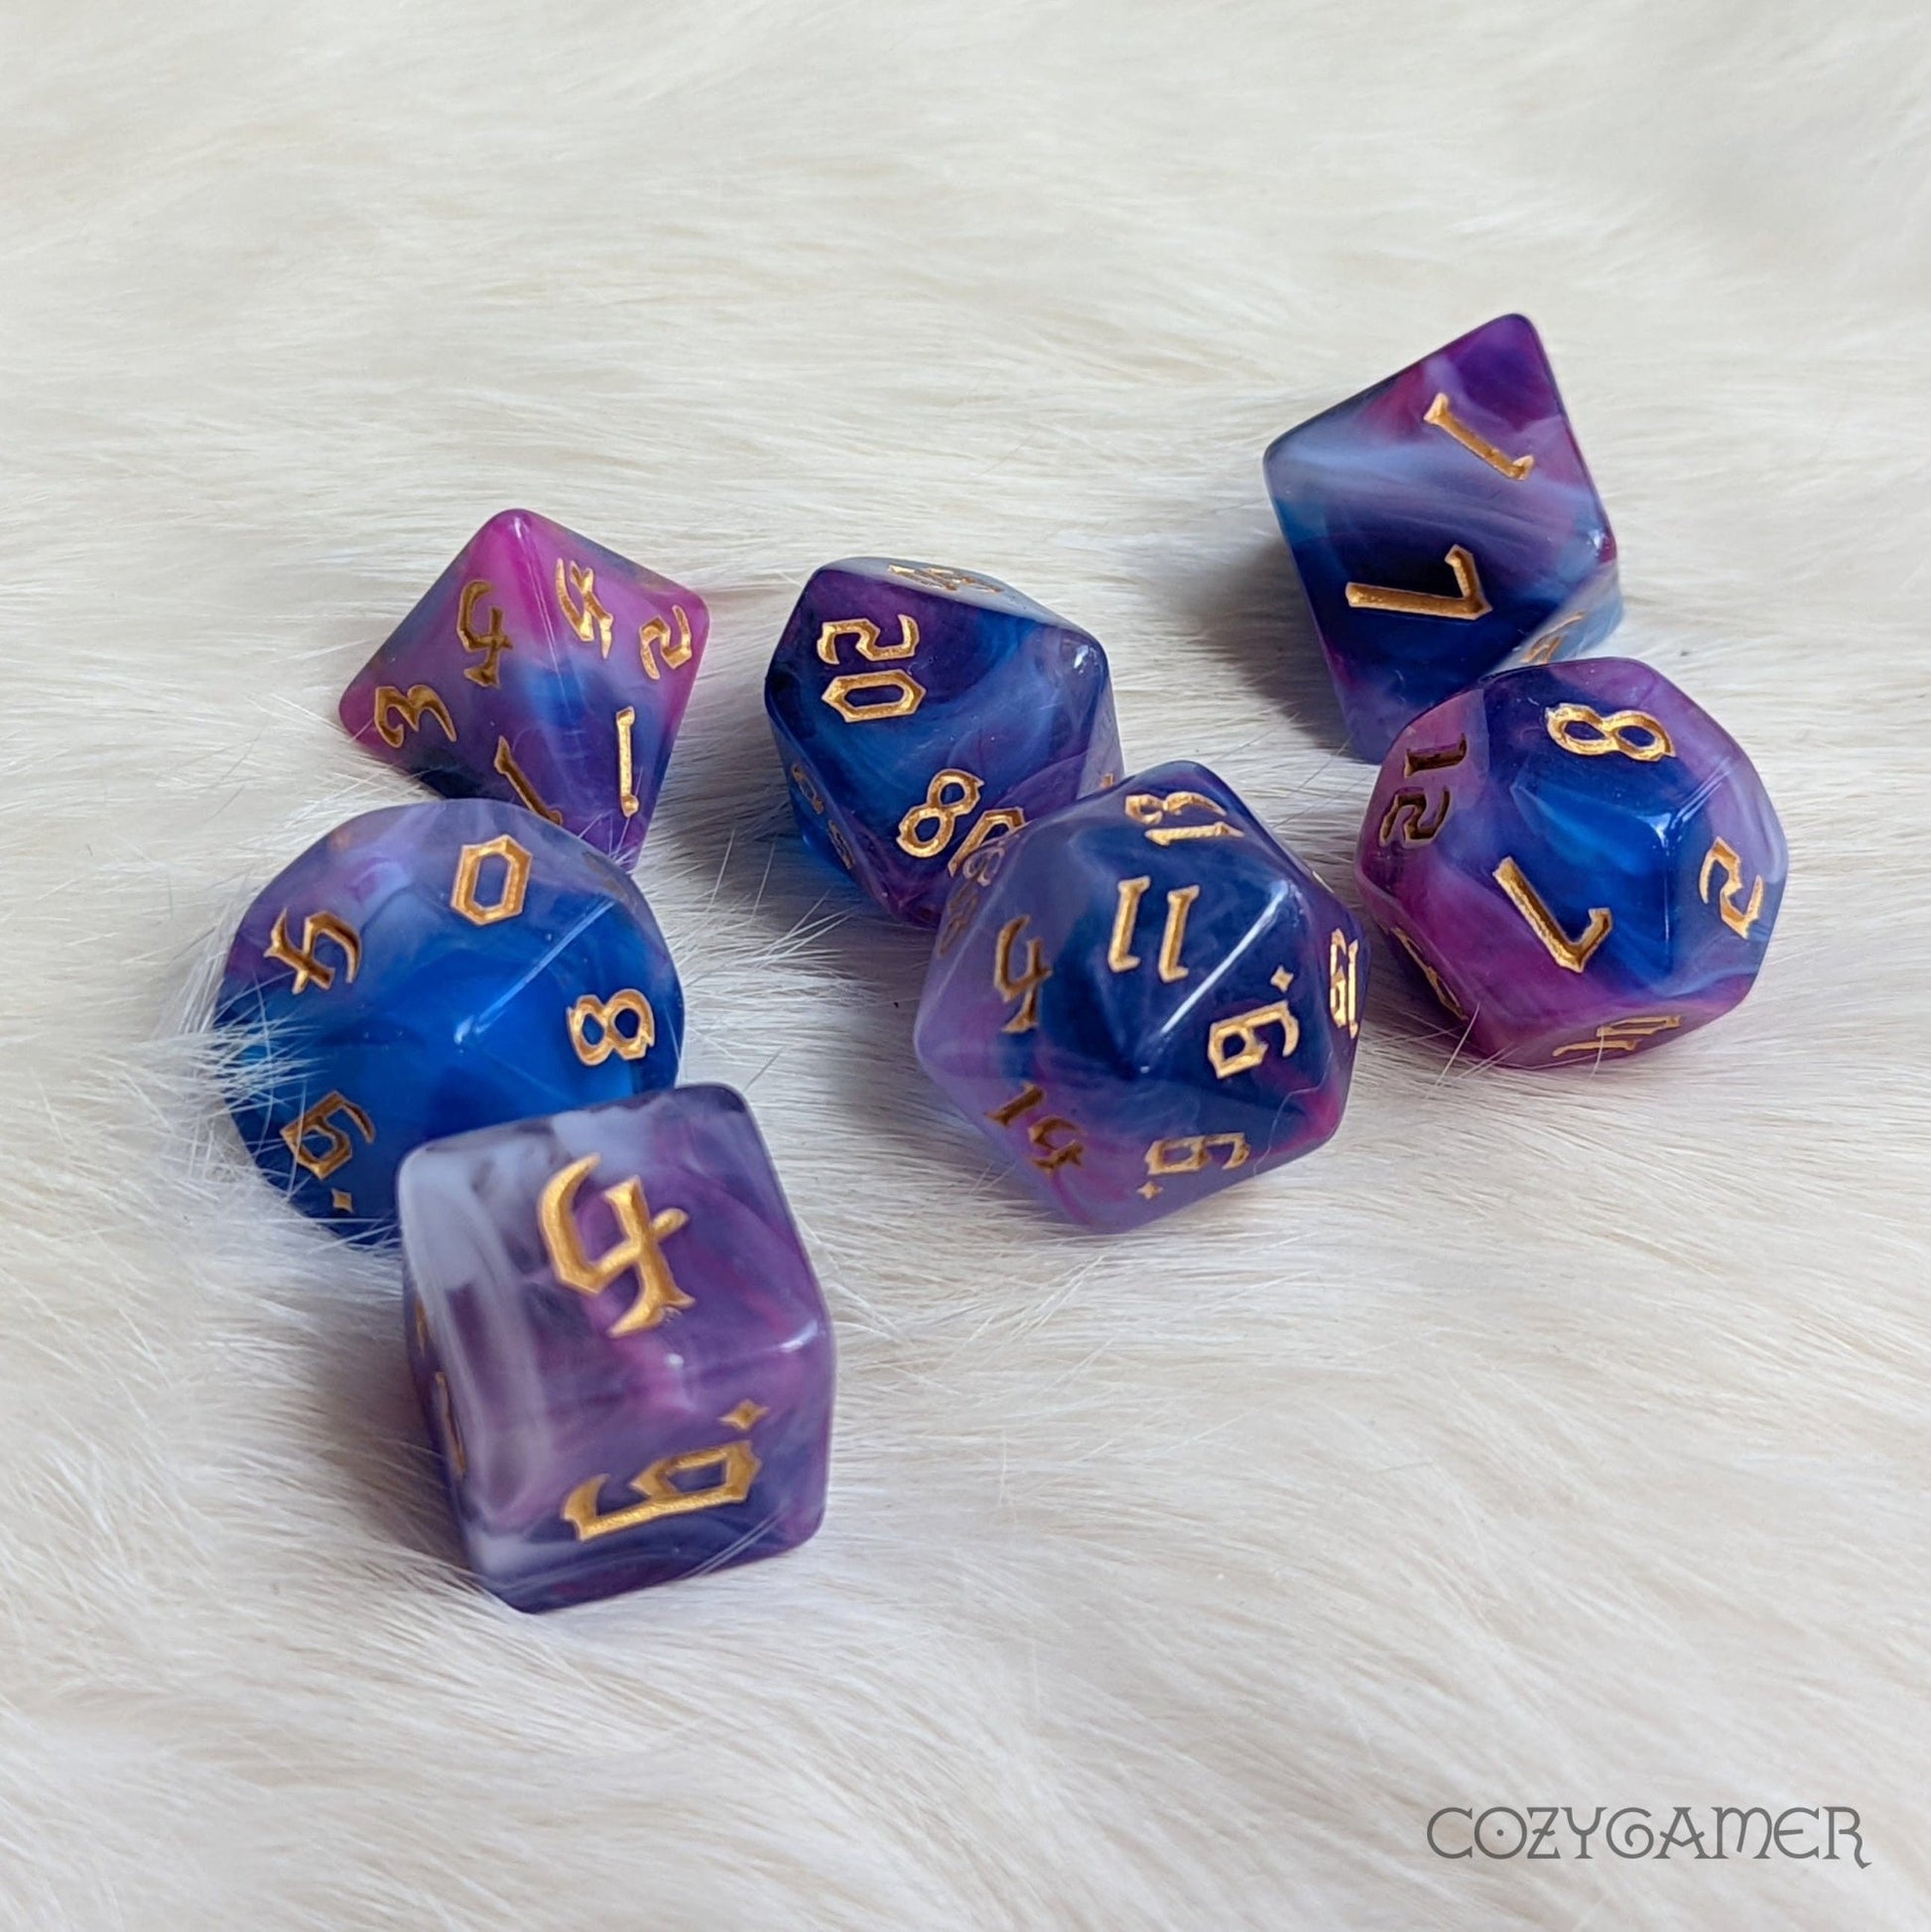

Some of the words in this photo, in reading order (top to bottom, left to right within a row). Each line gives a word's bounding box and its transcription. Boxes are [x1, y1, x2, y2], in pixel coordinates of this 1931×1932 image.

[817, 613, 927, 723] 20
[1545, 703, 1677, 762] 8
[1107, 875, 1201, 983] 11
[1492, 856, 1613, 973] 7
[566, 988, 656, 1067] 8
[536, 1151, 696, 1338] 4
